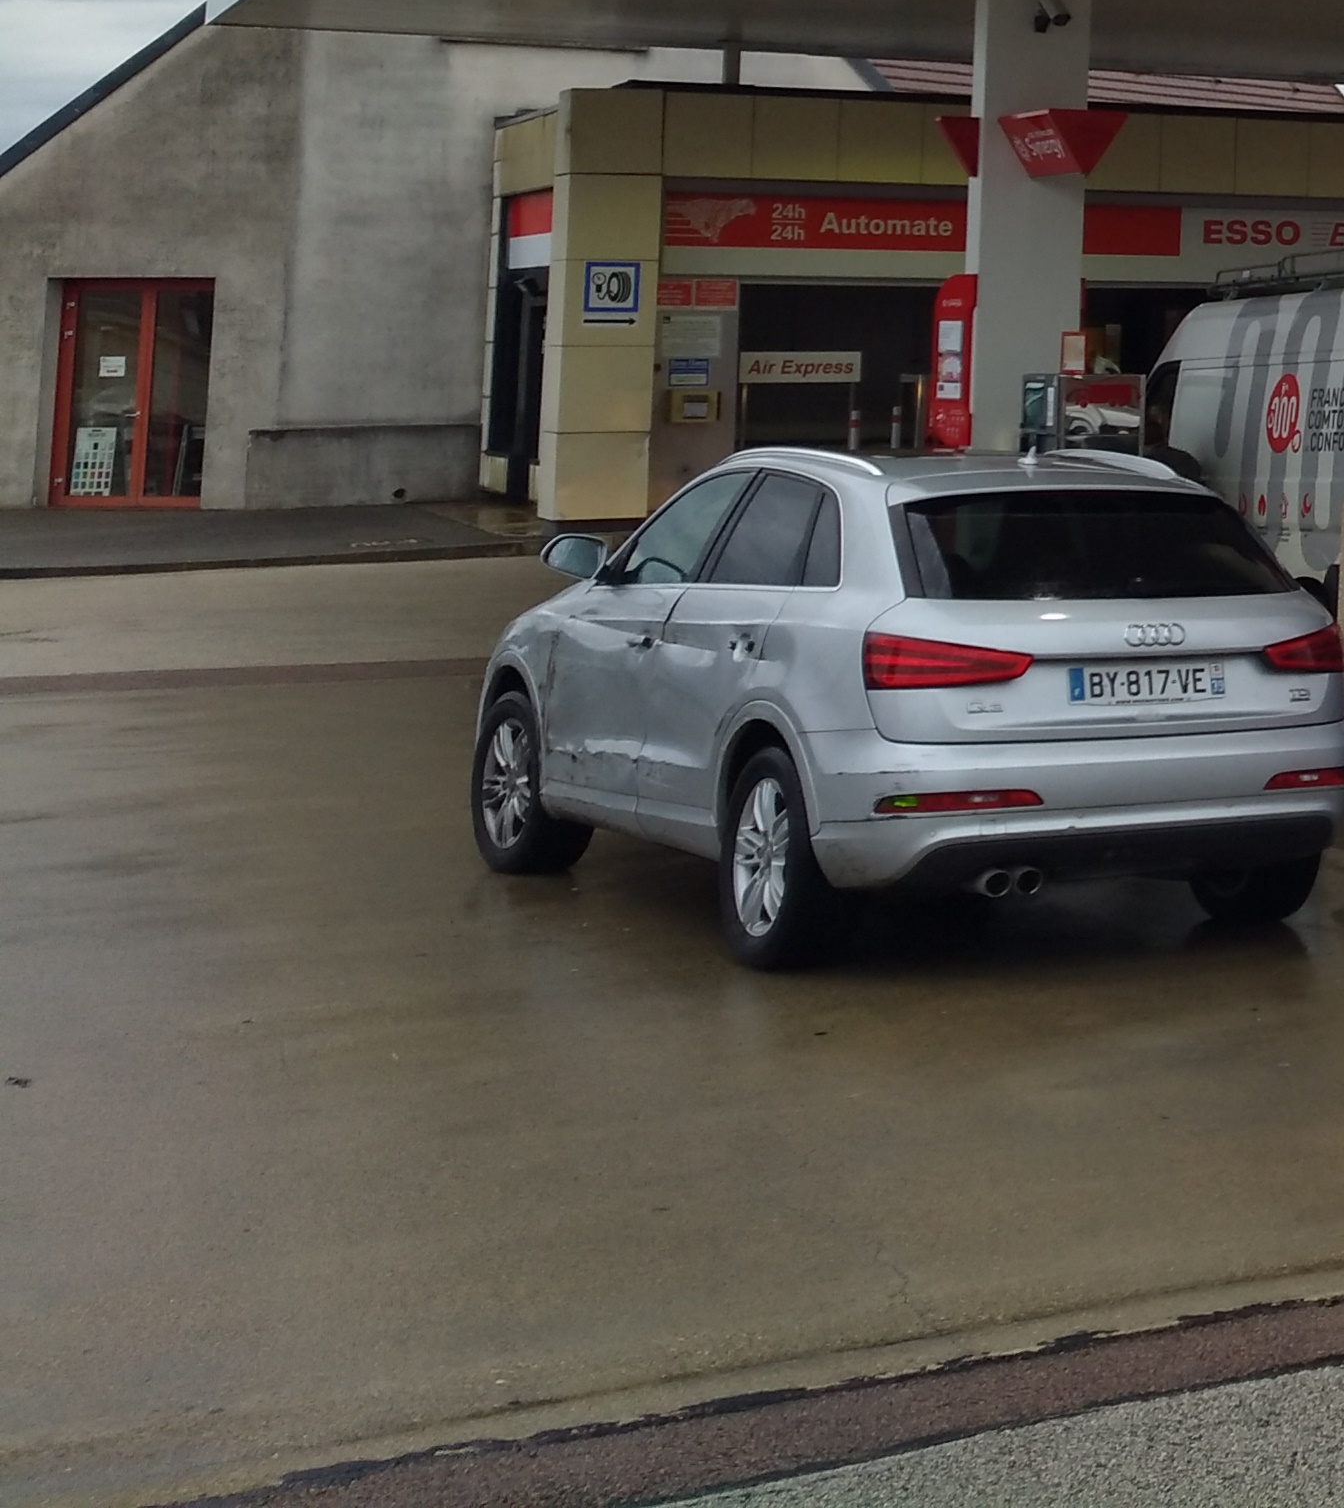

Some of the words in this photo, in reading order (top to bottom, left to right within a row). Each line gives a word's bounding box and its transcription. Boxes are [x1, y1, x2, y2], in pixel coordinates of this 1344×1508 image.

[772, 203, 806, 219] 24h
[770, 225, 806, 241] 24h
[819, 212, 954, 237] Automate
[1203, 219, 1301, 246] ESSO
[748, 359, 776, 375] Air
[781, 359, 854, 378] Express
[1089, 668, 1207, 699] BY-817-VE
